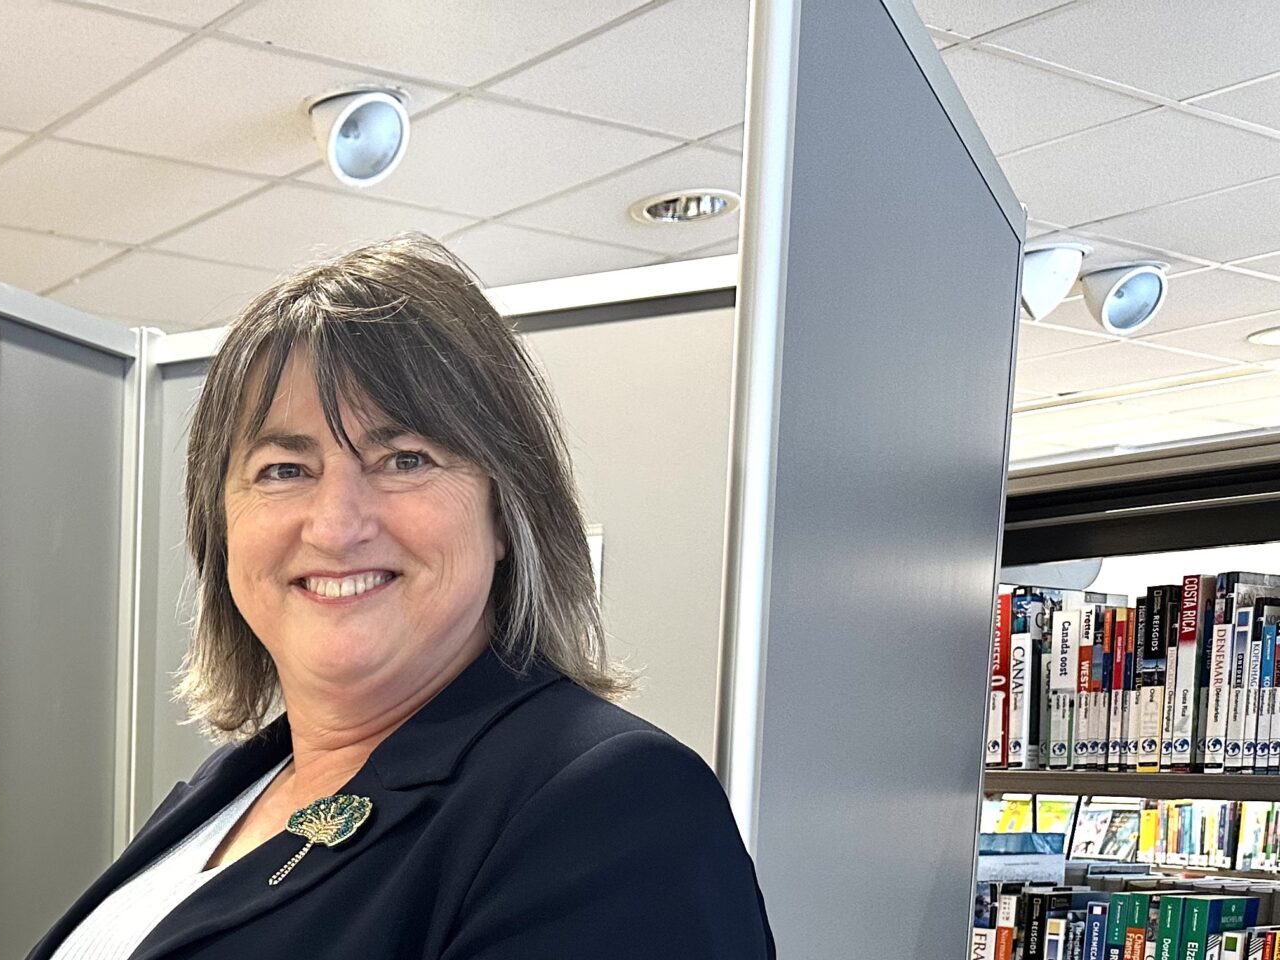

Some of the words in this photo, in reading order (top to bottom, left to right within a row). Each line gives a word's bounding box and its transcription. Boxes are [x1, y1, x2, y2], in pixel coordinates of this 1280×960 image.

[1183, 577, 1198, 609] COSTA
[1061, 620, 1071, 655] Canada
[1083, 609, 1093, 640] Trotter
[1151, 615, 1160, 652] REISGIDS
[1182, 609, 1197, 634] RICA
[1011, 645, 1026, 694] CANA
[1060, 656, 1068, 677] oost
[1213, 628, 1226, 688] DENEMAR
[1250, 643, 1260, 688] KOPENHAG
[1263, 676, 1271, 687] KO
[1029, 921, 1039, 955] REISGIDS
